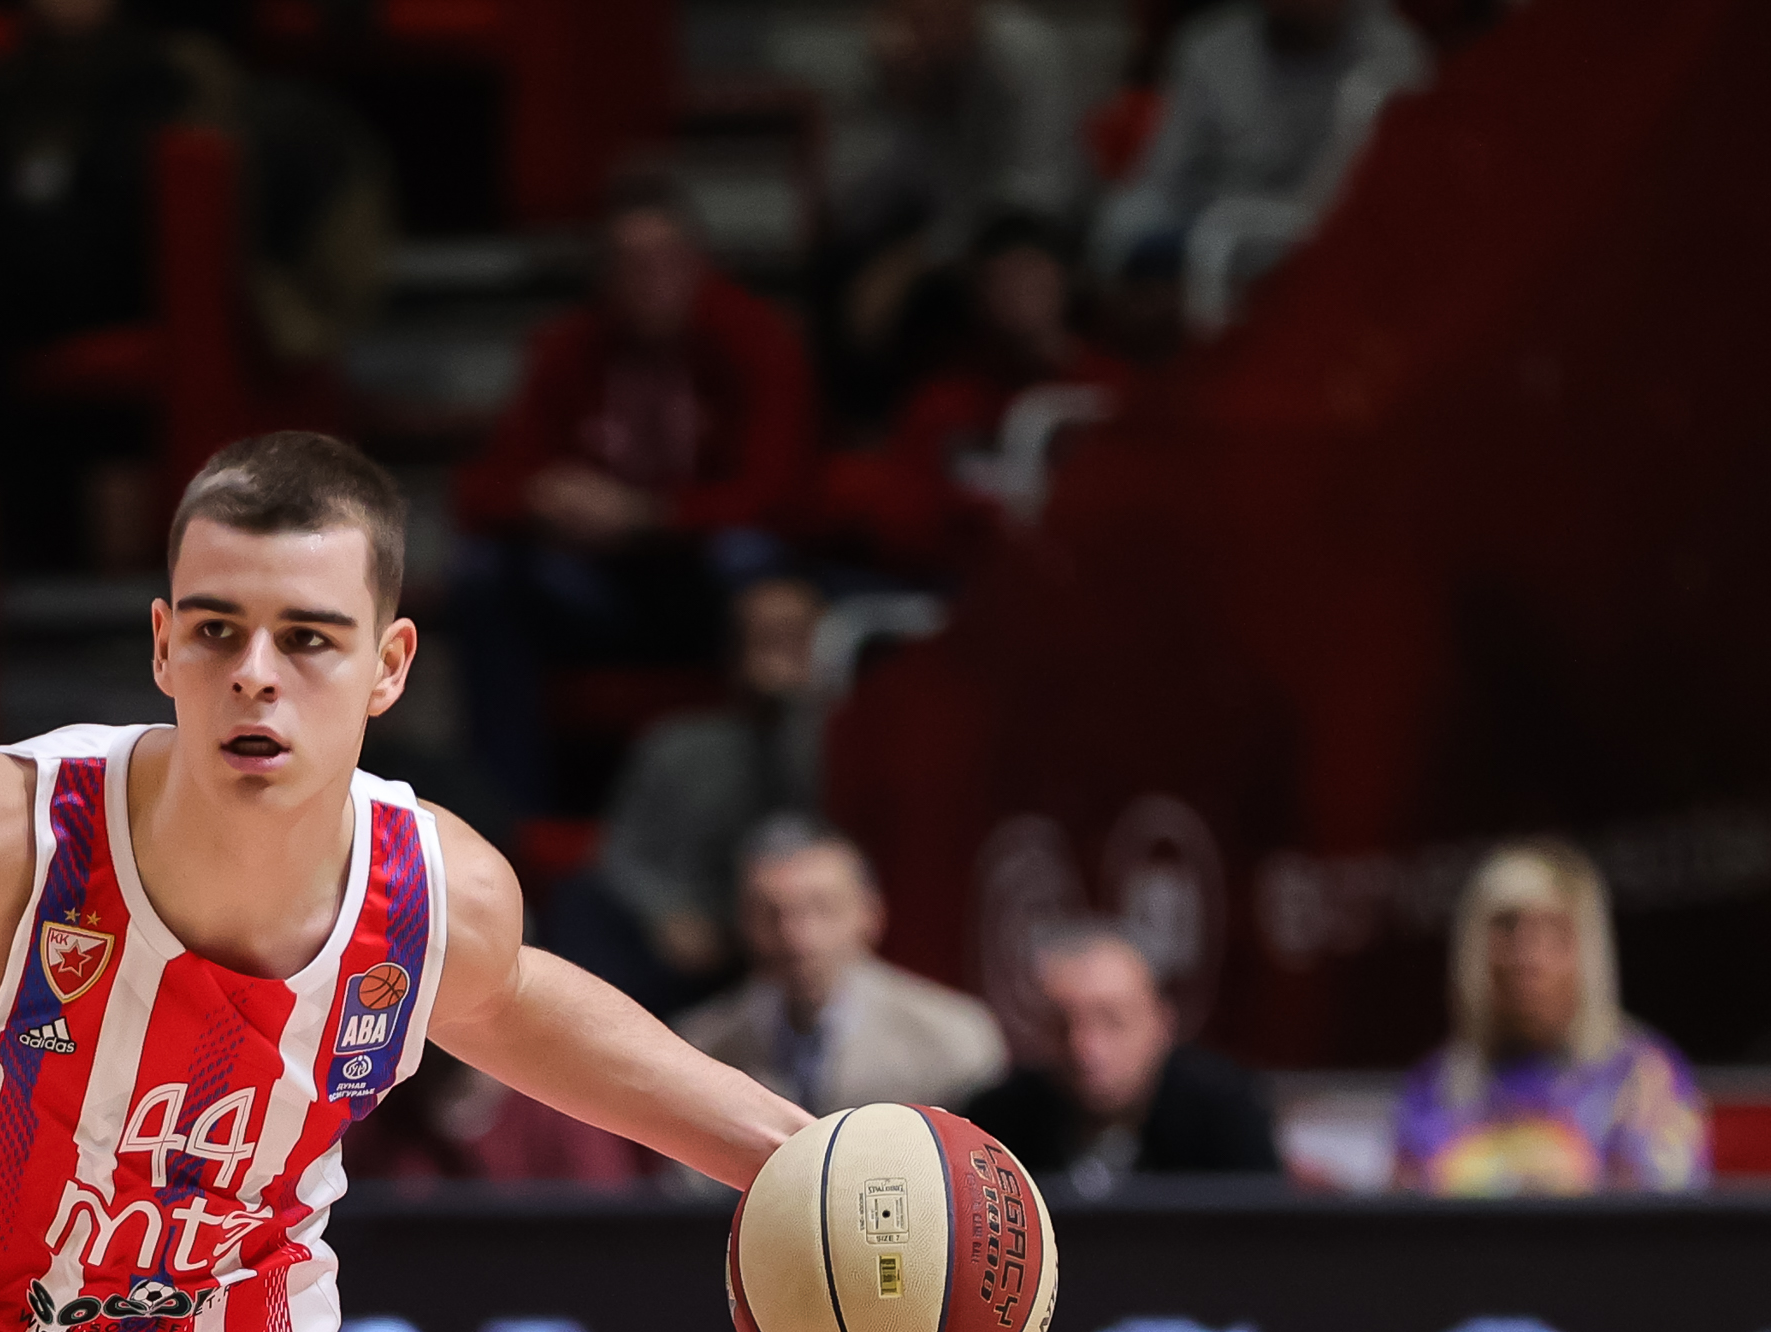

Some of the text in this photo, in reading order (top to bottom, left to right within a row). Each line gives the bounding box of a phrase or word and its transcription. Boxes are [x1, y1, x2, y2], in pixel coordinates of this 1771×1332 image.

[19, 1034, 75, 1053] adidas
[341, 1013, 387, 1047] ABA
[118, 1083, 256, 1188] 44
[983, 1143, 1027, 1328] LEGACY
